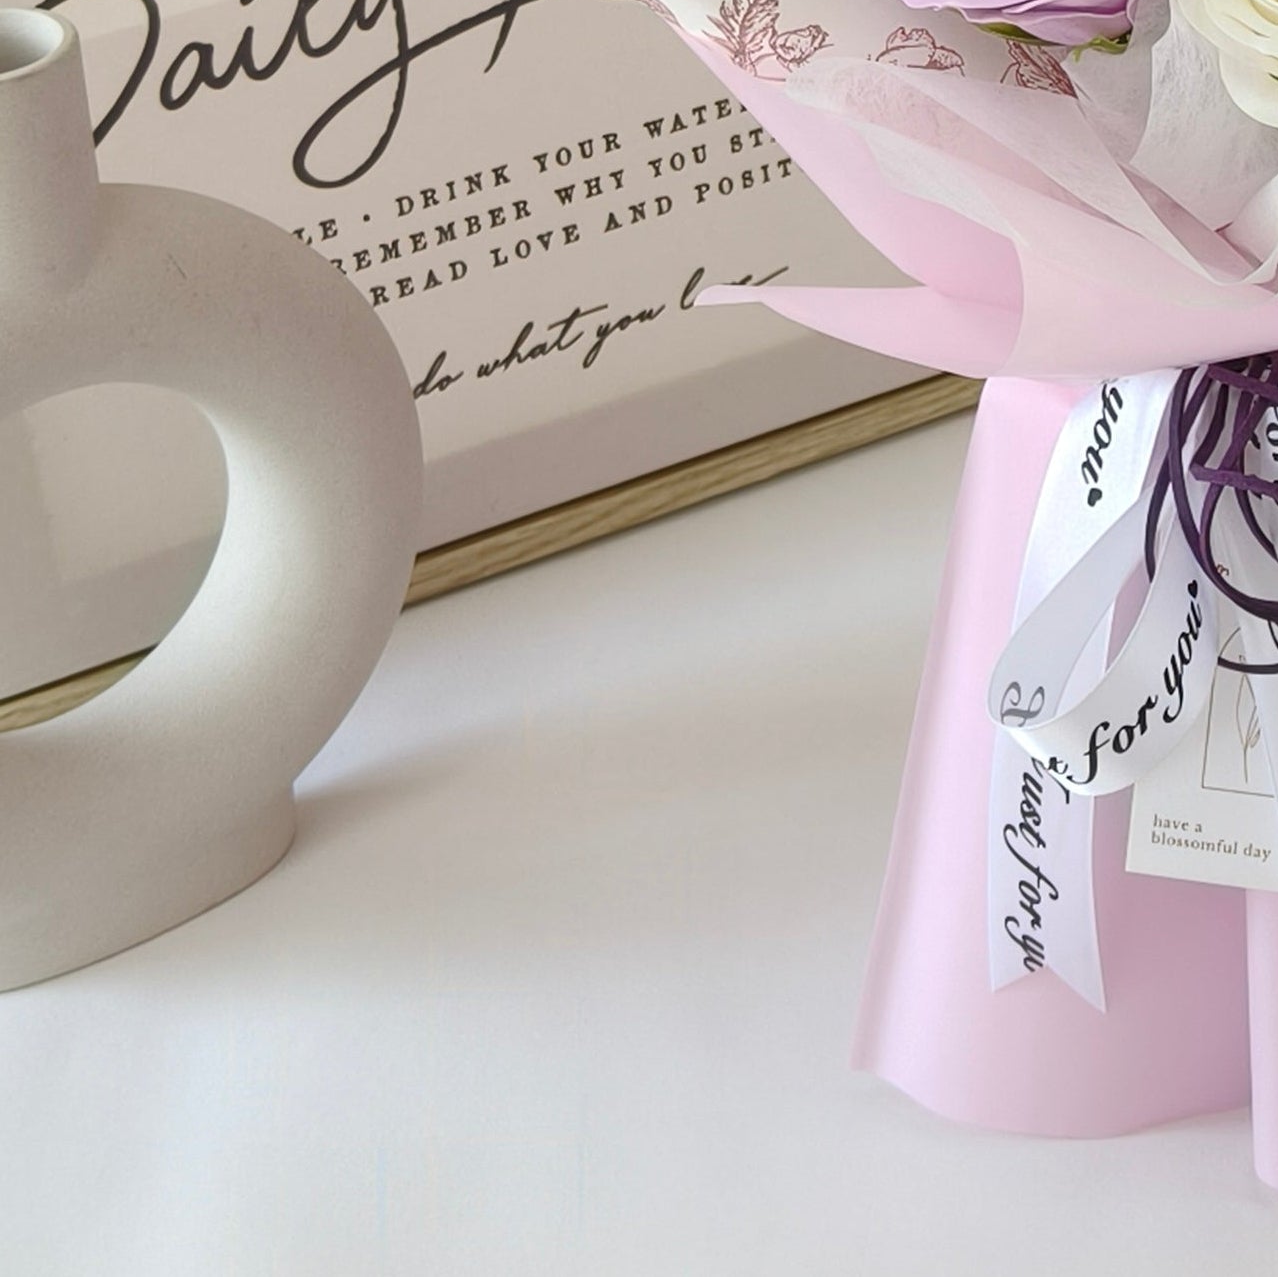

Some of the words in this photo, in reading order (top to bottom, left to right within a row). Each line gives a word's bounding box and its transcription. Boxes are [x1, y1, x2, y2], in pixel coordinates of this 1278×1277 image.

[395, 164, 511, 217] DRINK
[533, 132, 621, 173] YOUR
[643, 98, 748, 140] WATE
[554, 169, 624, 207] WHY
[648, 144, 707, 178] YOU
[729, 127, 776, 154] ST
[490, 223, 580, 268] LOVE
[603, 195, 673, 233] AND
[693, 157, 792, 204] POSIT
[413, 351, 463, 400] do
[477, 303, 608, 378] what
[583, 304, 665, 369] you
[1066, 694, 1158, 785] for
[1162, 600, 1202, 724] you
[1151, 830, 1238, 855] blossomful
[1243, 843, 1272, 863] day
[1153, 813, 1189, 832] have
[1194, 823, 1203, 833] a
[1003, 823, 1059, 930] for
